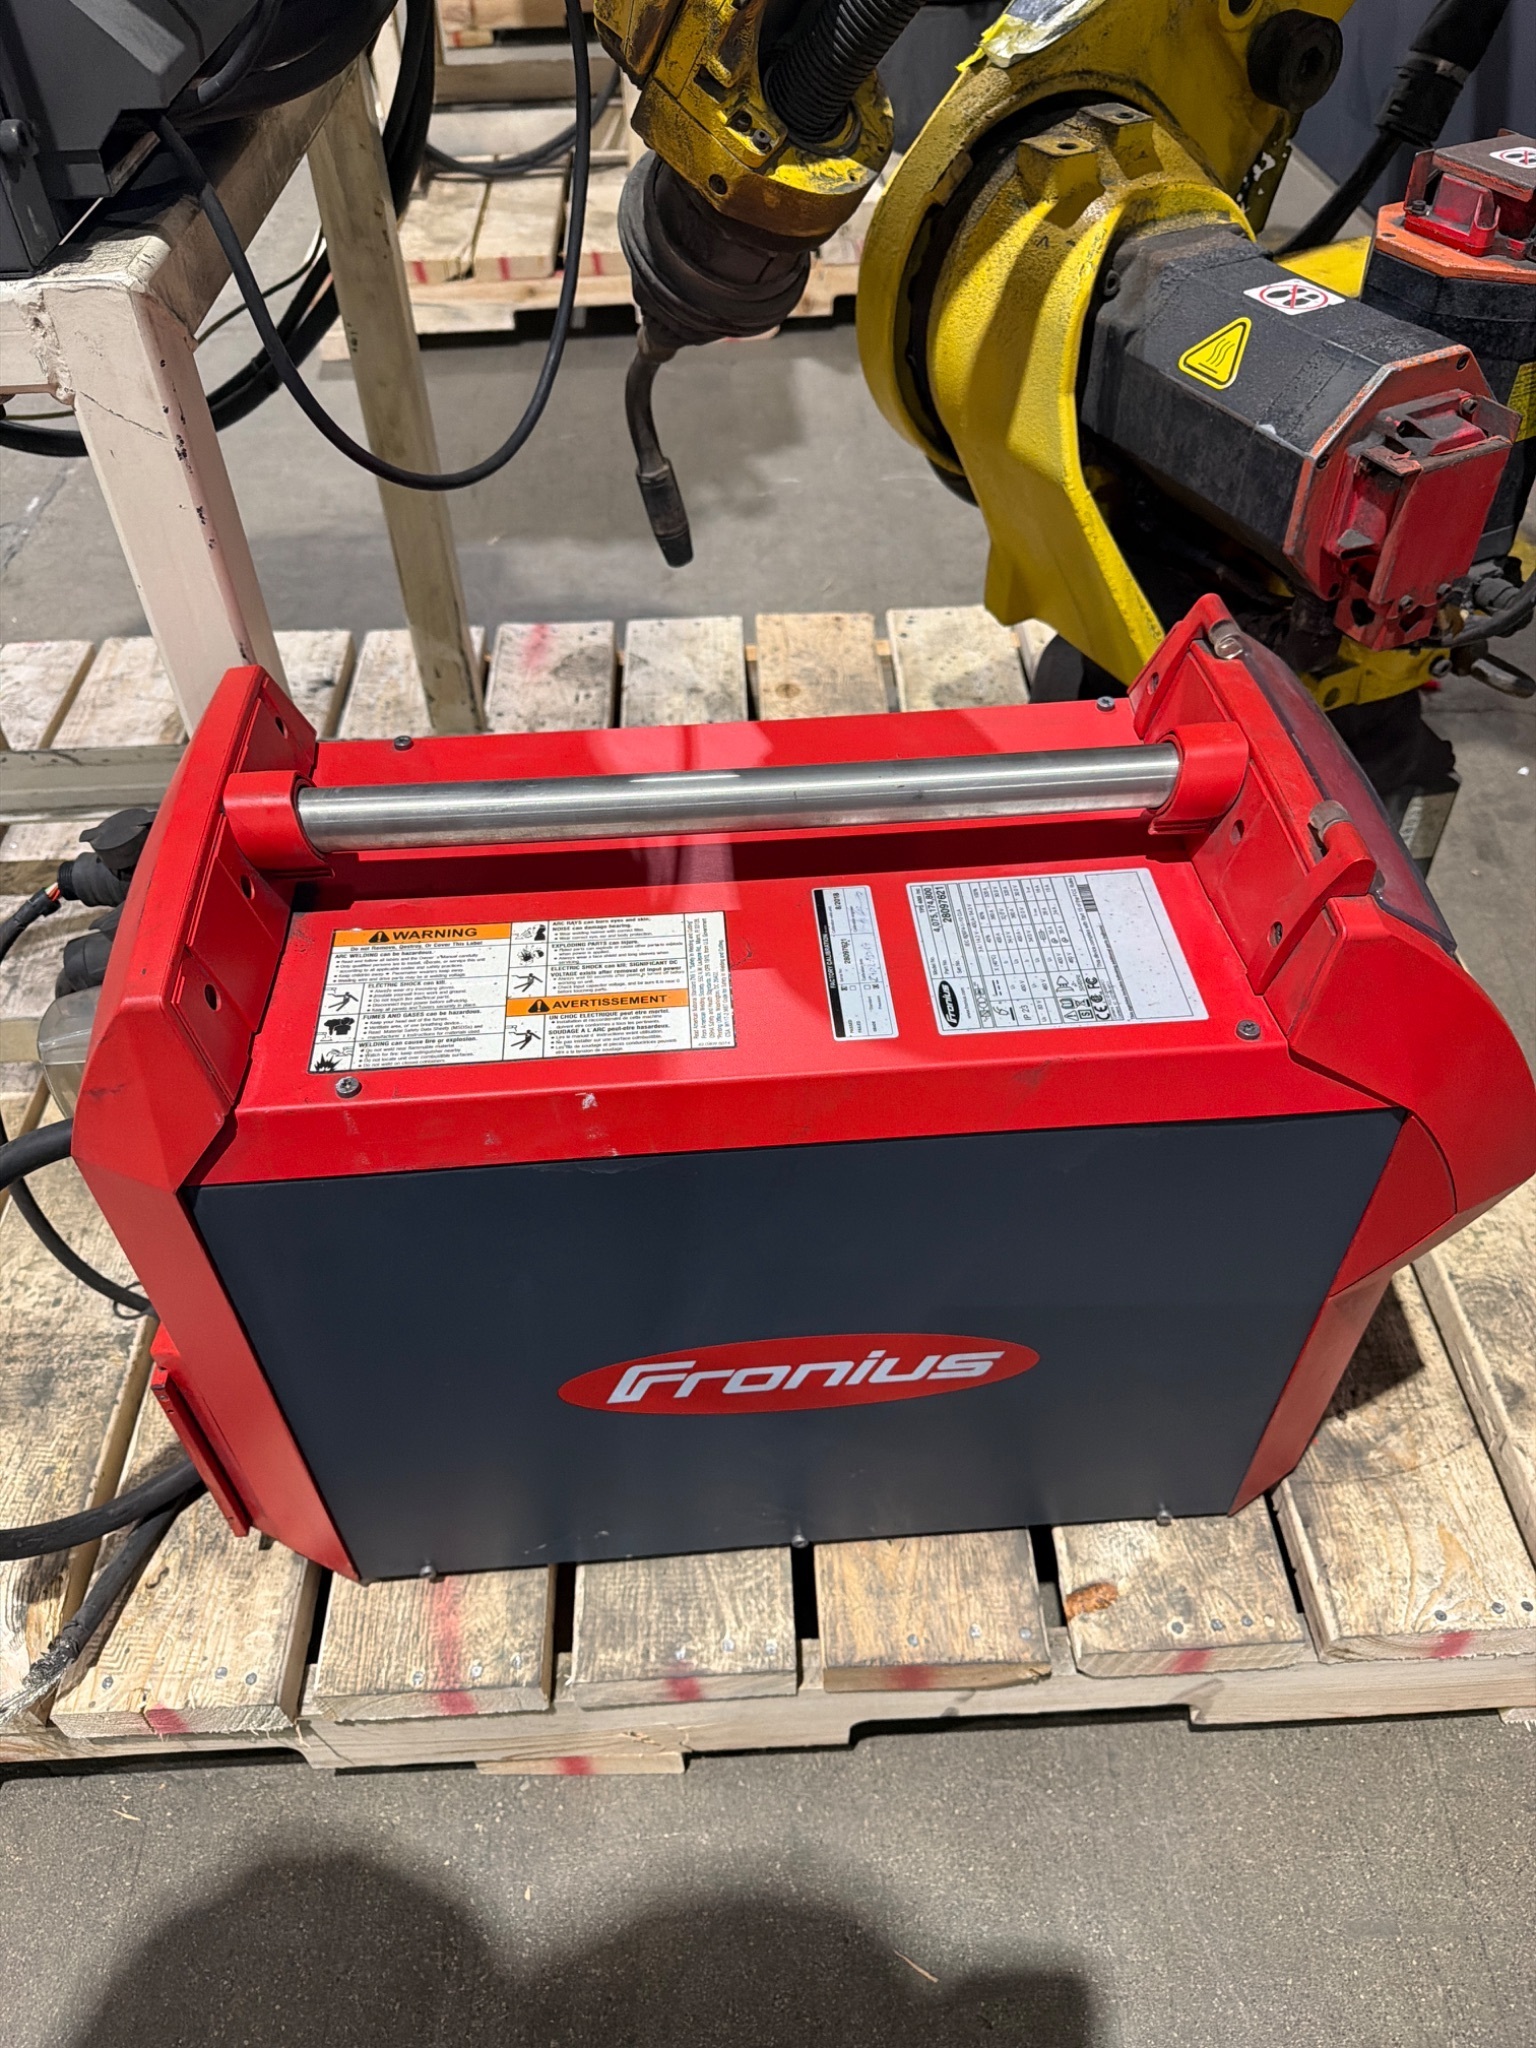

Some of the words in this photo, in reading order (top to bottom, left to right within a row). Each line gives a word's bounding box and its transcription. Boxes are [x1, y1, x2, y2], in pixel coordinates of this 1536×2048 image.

[832, 892, 841, 909] 8/2018
[924, 887, 941, 932] 4,075,174,800
[936, 887, 952, 922] 28097621
[392, 927, 477, 940] WARNING
[822, 933, 832, 965] CALIBRATION
[840, 938, 850, 964] 28097621
[828, 965, 836, 988] FACTORY
[552, 994, 666, 1009] AVERTISSEMENT
[942, 984, 957, 1023] Fronius
[607, 1349, 1005, 1404] Fronius
